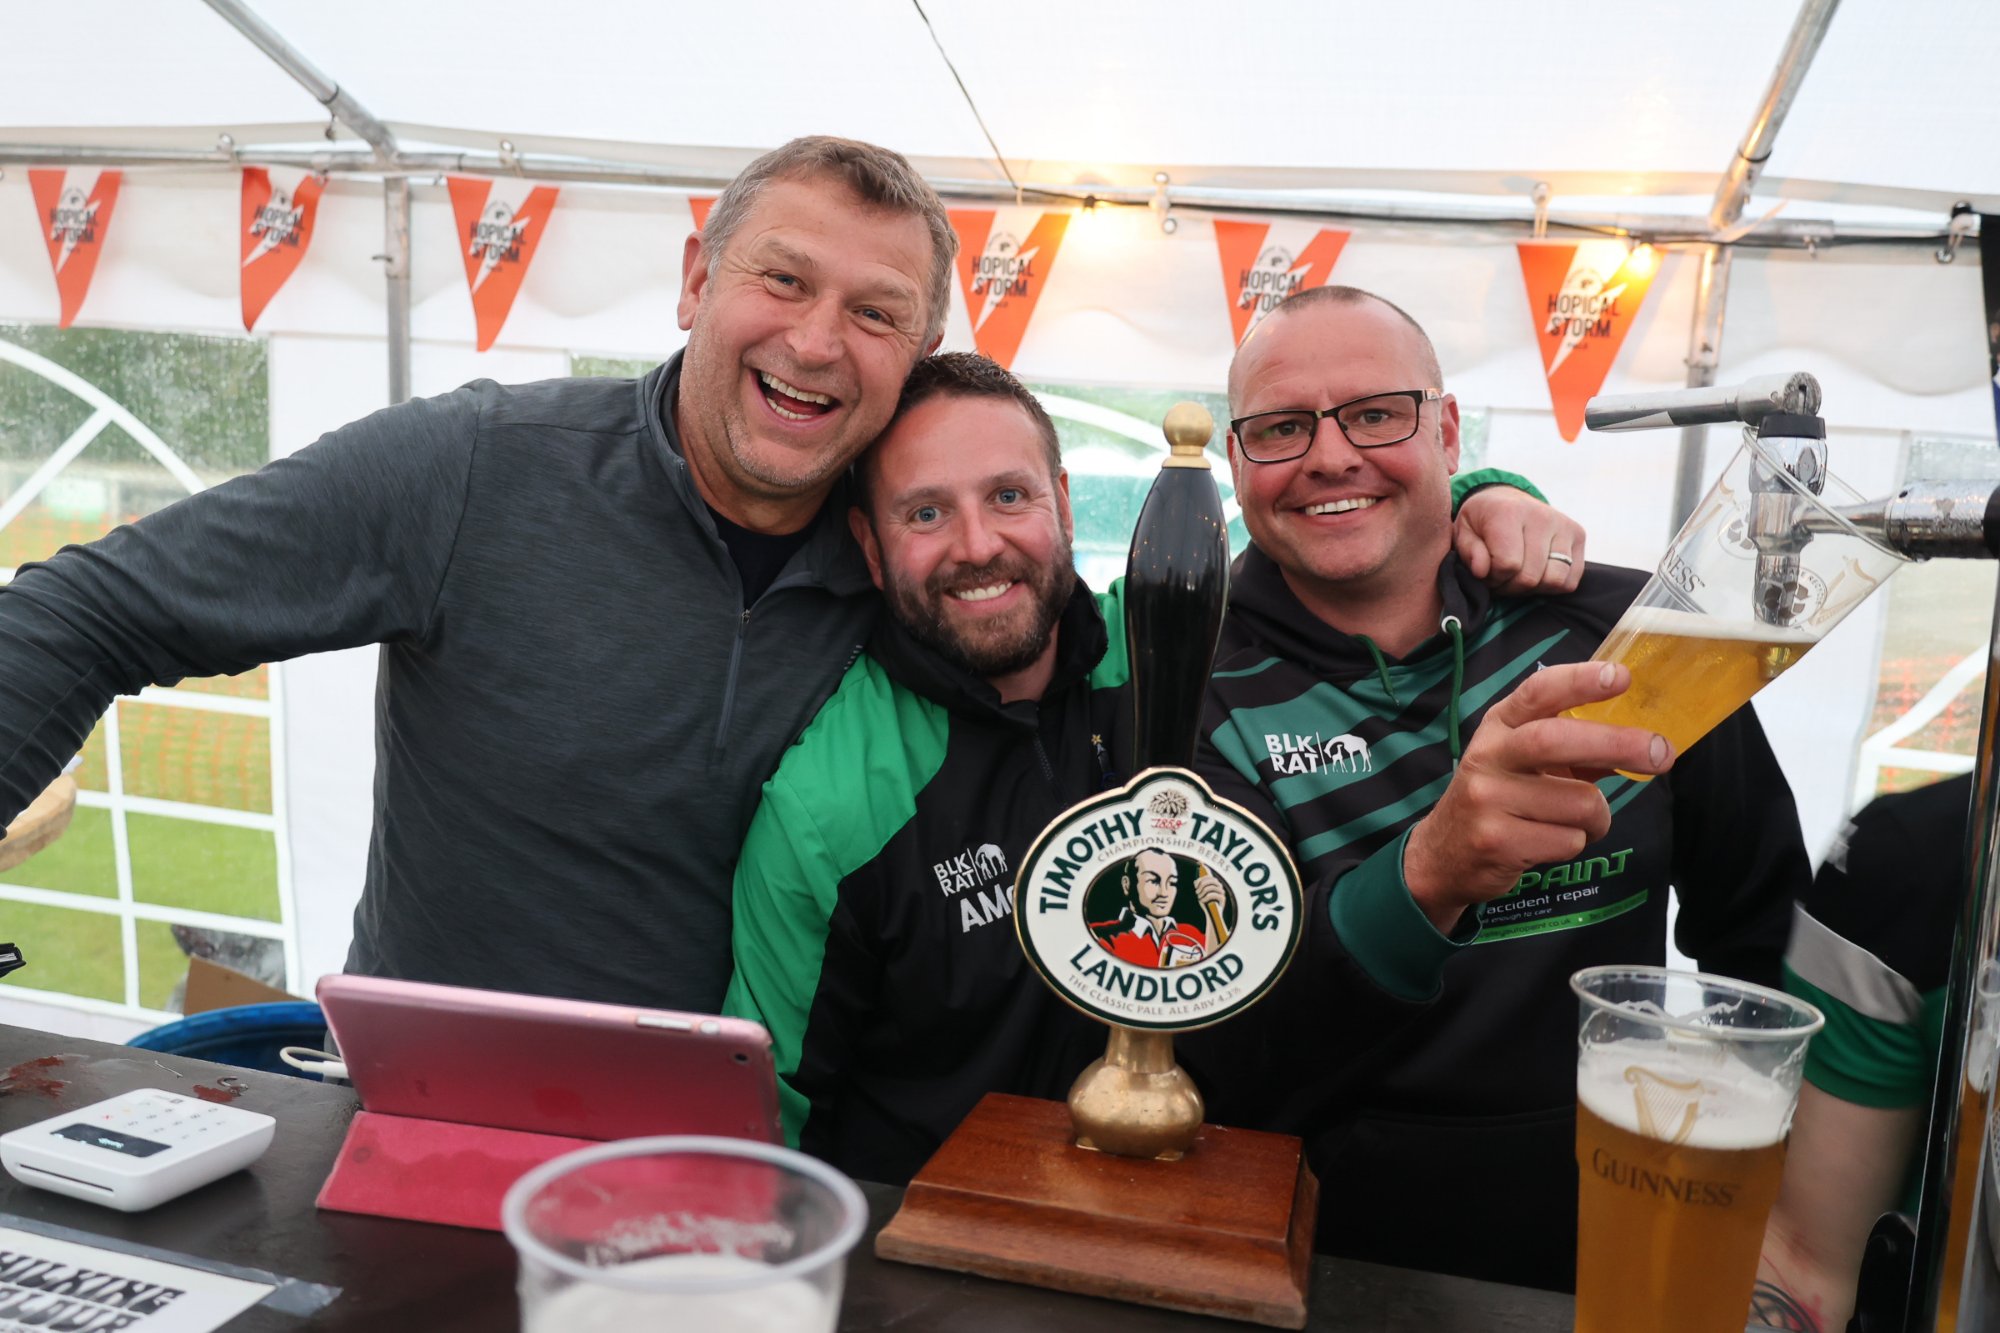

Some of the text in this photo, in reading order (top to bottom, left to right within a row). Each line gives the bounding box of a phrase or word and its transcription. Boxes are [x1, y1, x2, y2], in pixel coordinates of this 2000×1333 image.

[50, 208, 98, 227] HOPICAL
[254, 204, 305, 231] HOPICAL
[53, 226, 95, 243] STORM
[252, 223, 299, 247] STORM
[470, 221, 526, 245] HOPICAL
[472, 241, 519, 263] STORM
[972, 255, 1034, 277] HOPICAL
[975, 276, 1027, 297] STORM
[1547, 293, 1620, 316] HOPICAL
[1550, 316, 1611, 337] STORM
[1264, 733, 1317, 753] BLK
[1269, 752, 1318, 774] RAT
[1097, 836, 1231, 872] CHAMPIONSHIP BEERS
[933, 852, 972, 881] BLK
[1039, 808, 1285, 932] TIMOTHY TAYLOR'S
[1497, 848, 1633, 899] PAINT
[940, 868, 975, 897] RAT
[1486, 885, 1600, 915] accident repair
[1534, 908, 1553, 916] care
[1070, 943, 1243, 1003] LANDLORD
[1068, 973, 1089, 992] THE
[1090, 989, 1134, 1013] CLASSIC
[1136, 1004, 1164, 1015] PALE
[1169, 1003, 1190, 1015] ALE
[1193, 998, 1215, 1012] ABV
[1592, 1147, 1736, 1208] GUINNESS
